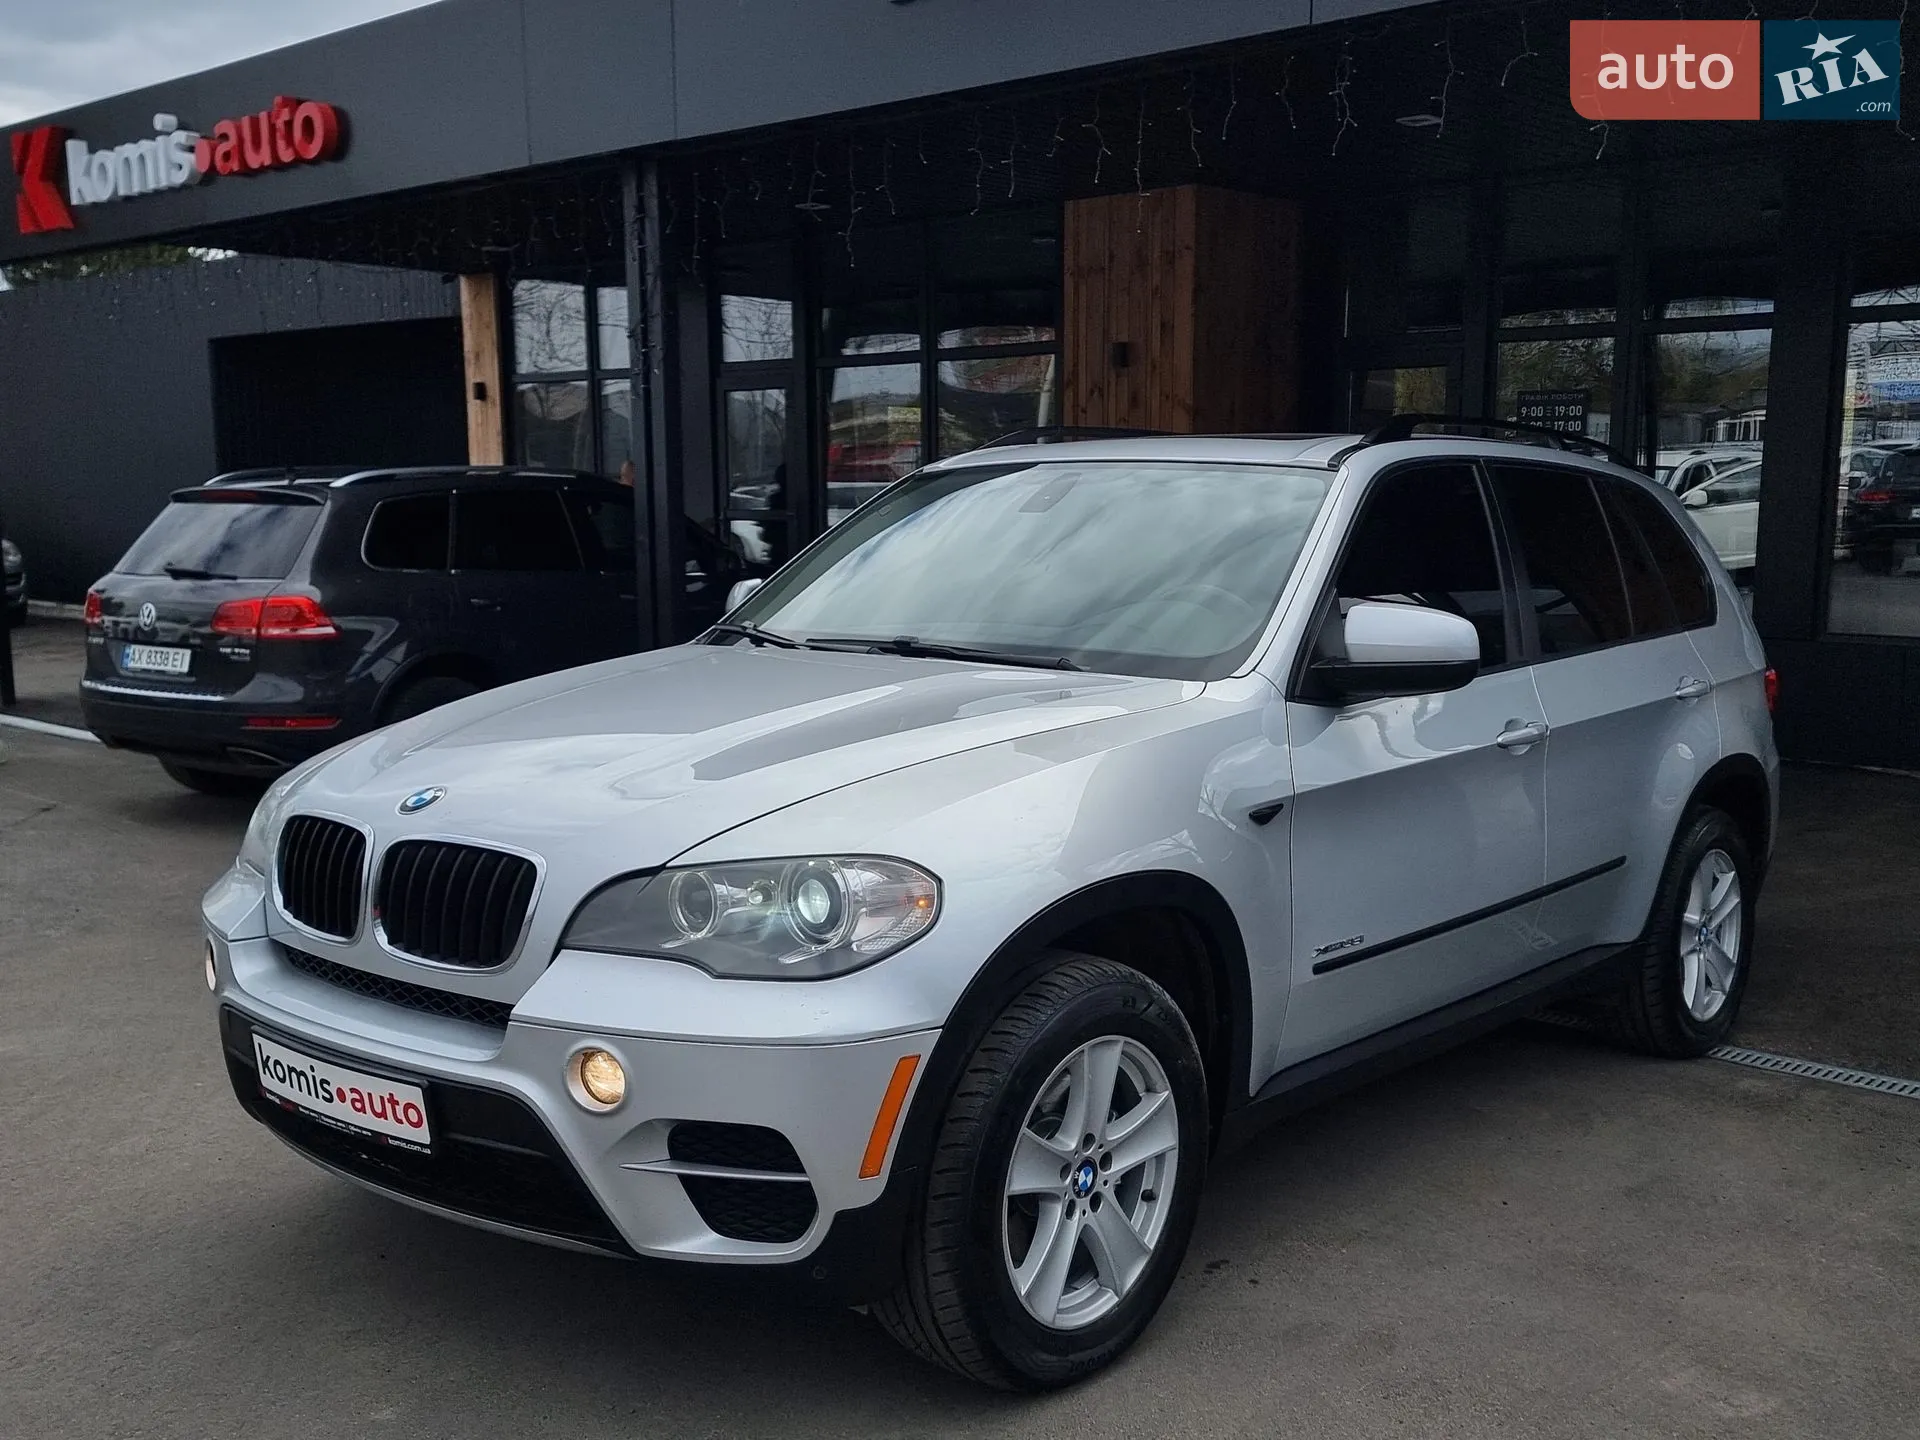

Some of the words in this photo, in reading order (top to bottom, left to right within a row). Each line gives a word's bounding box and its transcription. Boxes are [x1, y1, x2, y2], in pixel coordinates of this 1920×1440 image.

[1521, 406, 1544, 417] 9:00
[1555, 405, 1583, 416] 19:00
[1554, 421, 1582, 431] 17:00
[130, 647, 145, 664] AX
[146, 649, 170, 666] 8338
